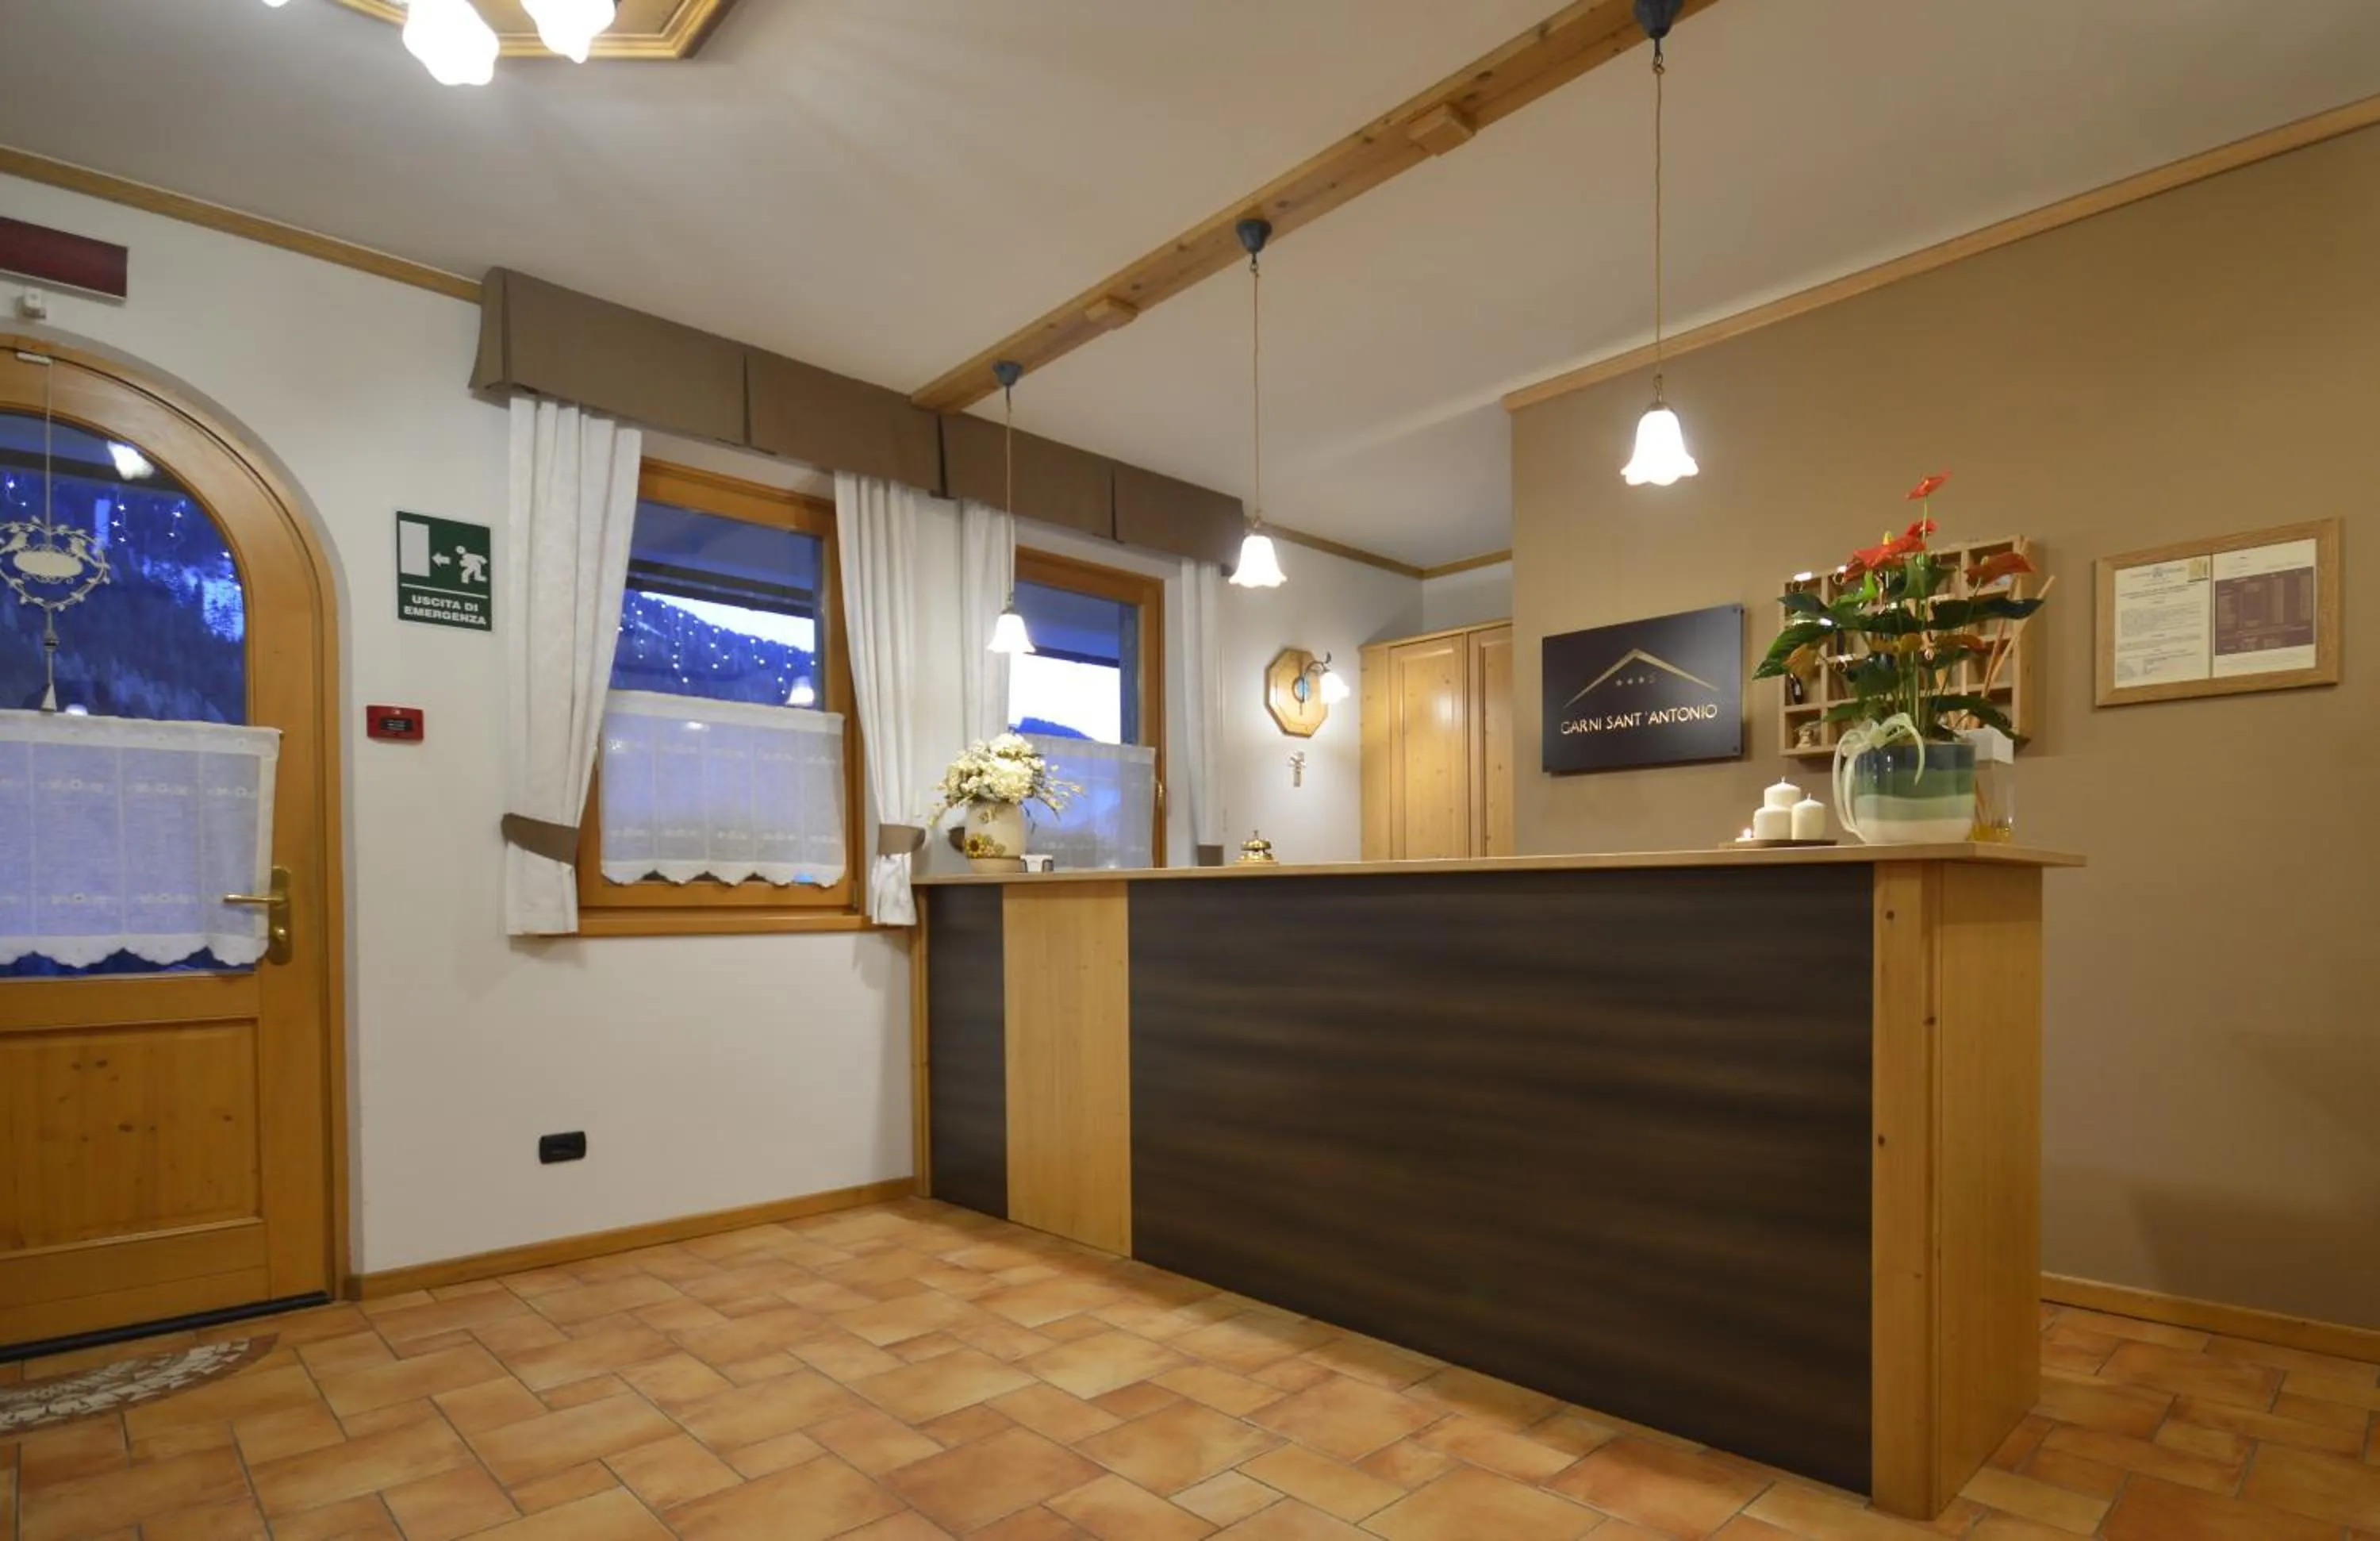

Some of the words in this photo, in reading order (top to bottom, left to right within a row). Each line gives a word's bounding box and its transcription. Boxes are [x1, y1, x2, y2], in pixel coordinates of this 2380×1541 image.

[412, 594, 460, 609] USCITA
[464, 602, 478, 612] DI
[404, 605, 486, 624] EMERGENZA
[1560, 717, 1603, 735] GARNI
